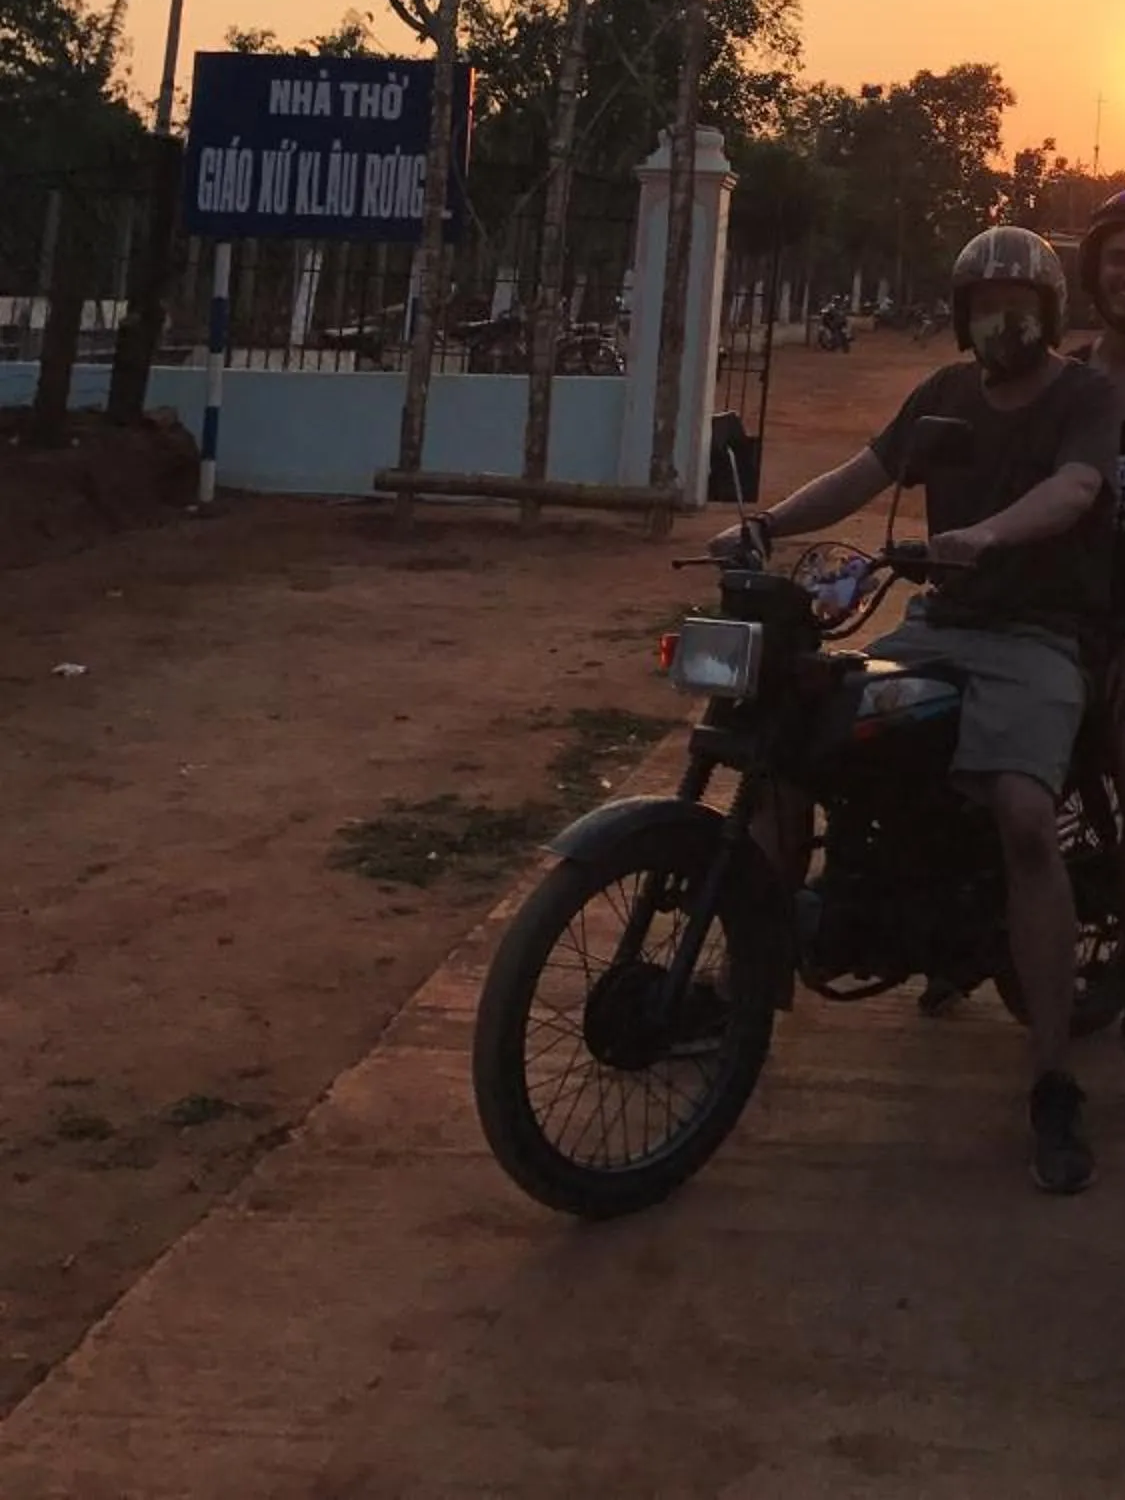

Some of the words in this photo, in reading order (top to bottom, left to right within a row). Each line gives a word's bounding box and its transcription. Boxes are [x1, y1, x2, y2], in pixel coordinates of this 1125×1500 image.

[268, 68, 332, 118] NHÀ
[339, 71, 410, 121] THỜ
[197, 135, 254, 214] GIÁO
[294, 138, 359, 219] KLÂU
